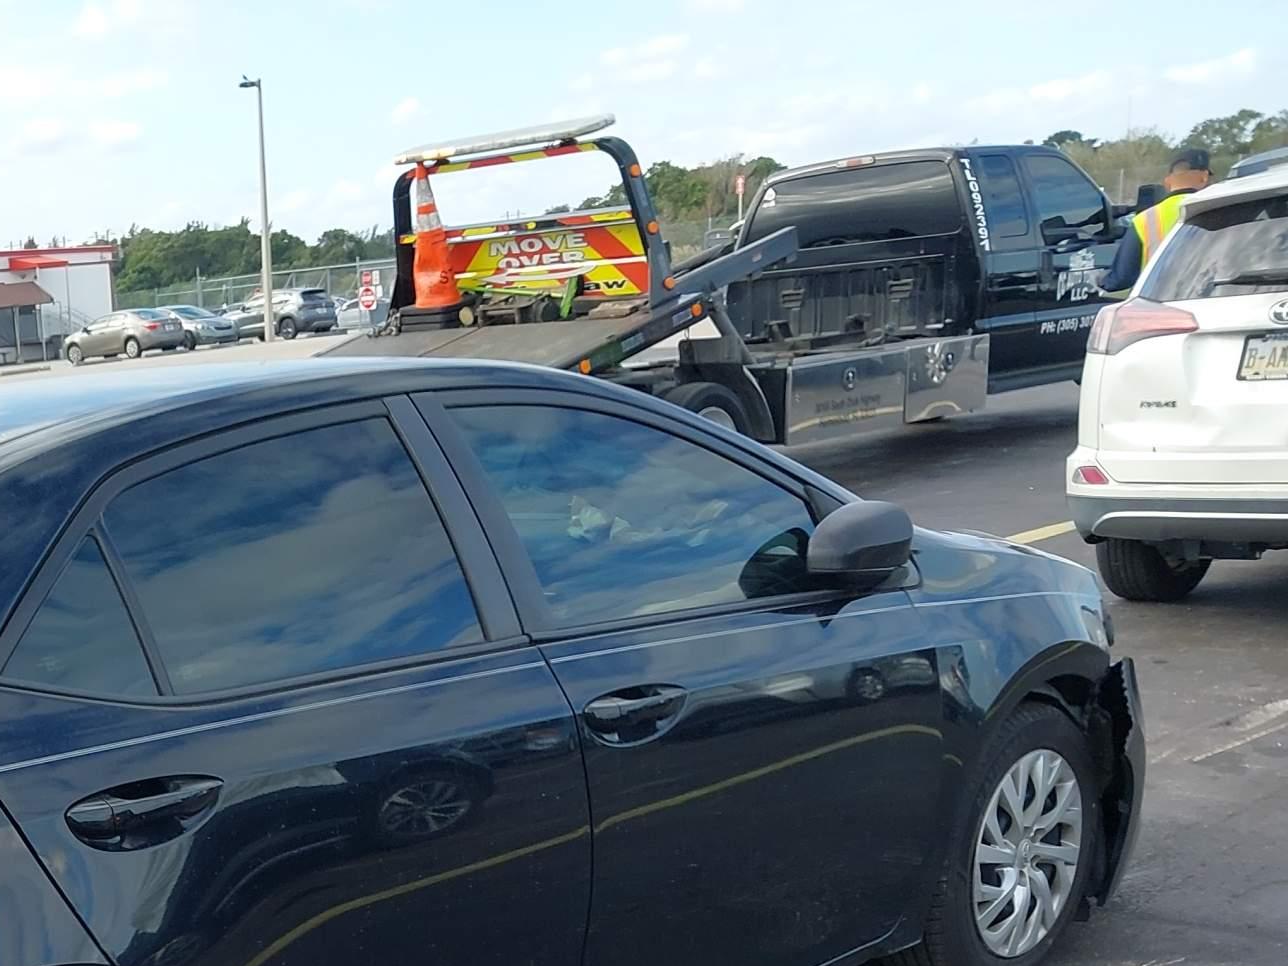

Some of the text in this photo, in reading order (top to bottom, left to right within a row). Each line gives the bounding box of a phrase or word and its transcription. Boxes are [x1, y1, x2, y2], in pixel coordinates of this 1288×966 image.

[489, 233, 588, 257] MOVE
[497, 250, 585, 270] OVER
[1070, 286, 1089, 302] LLC
